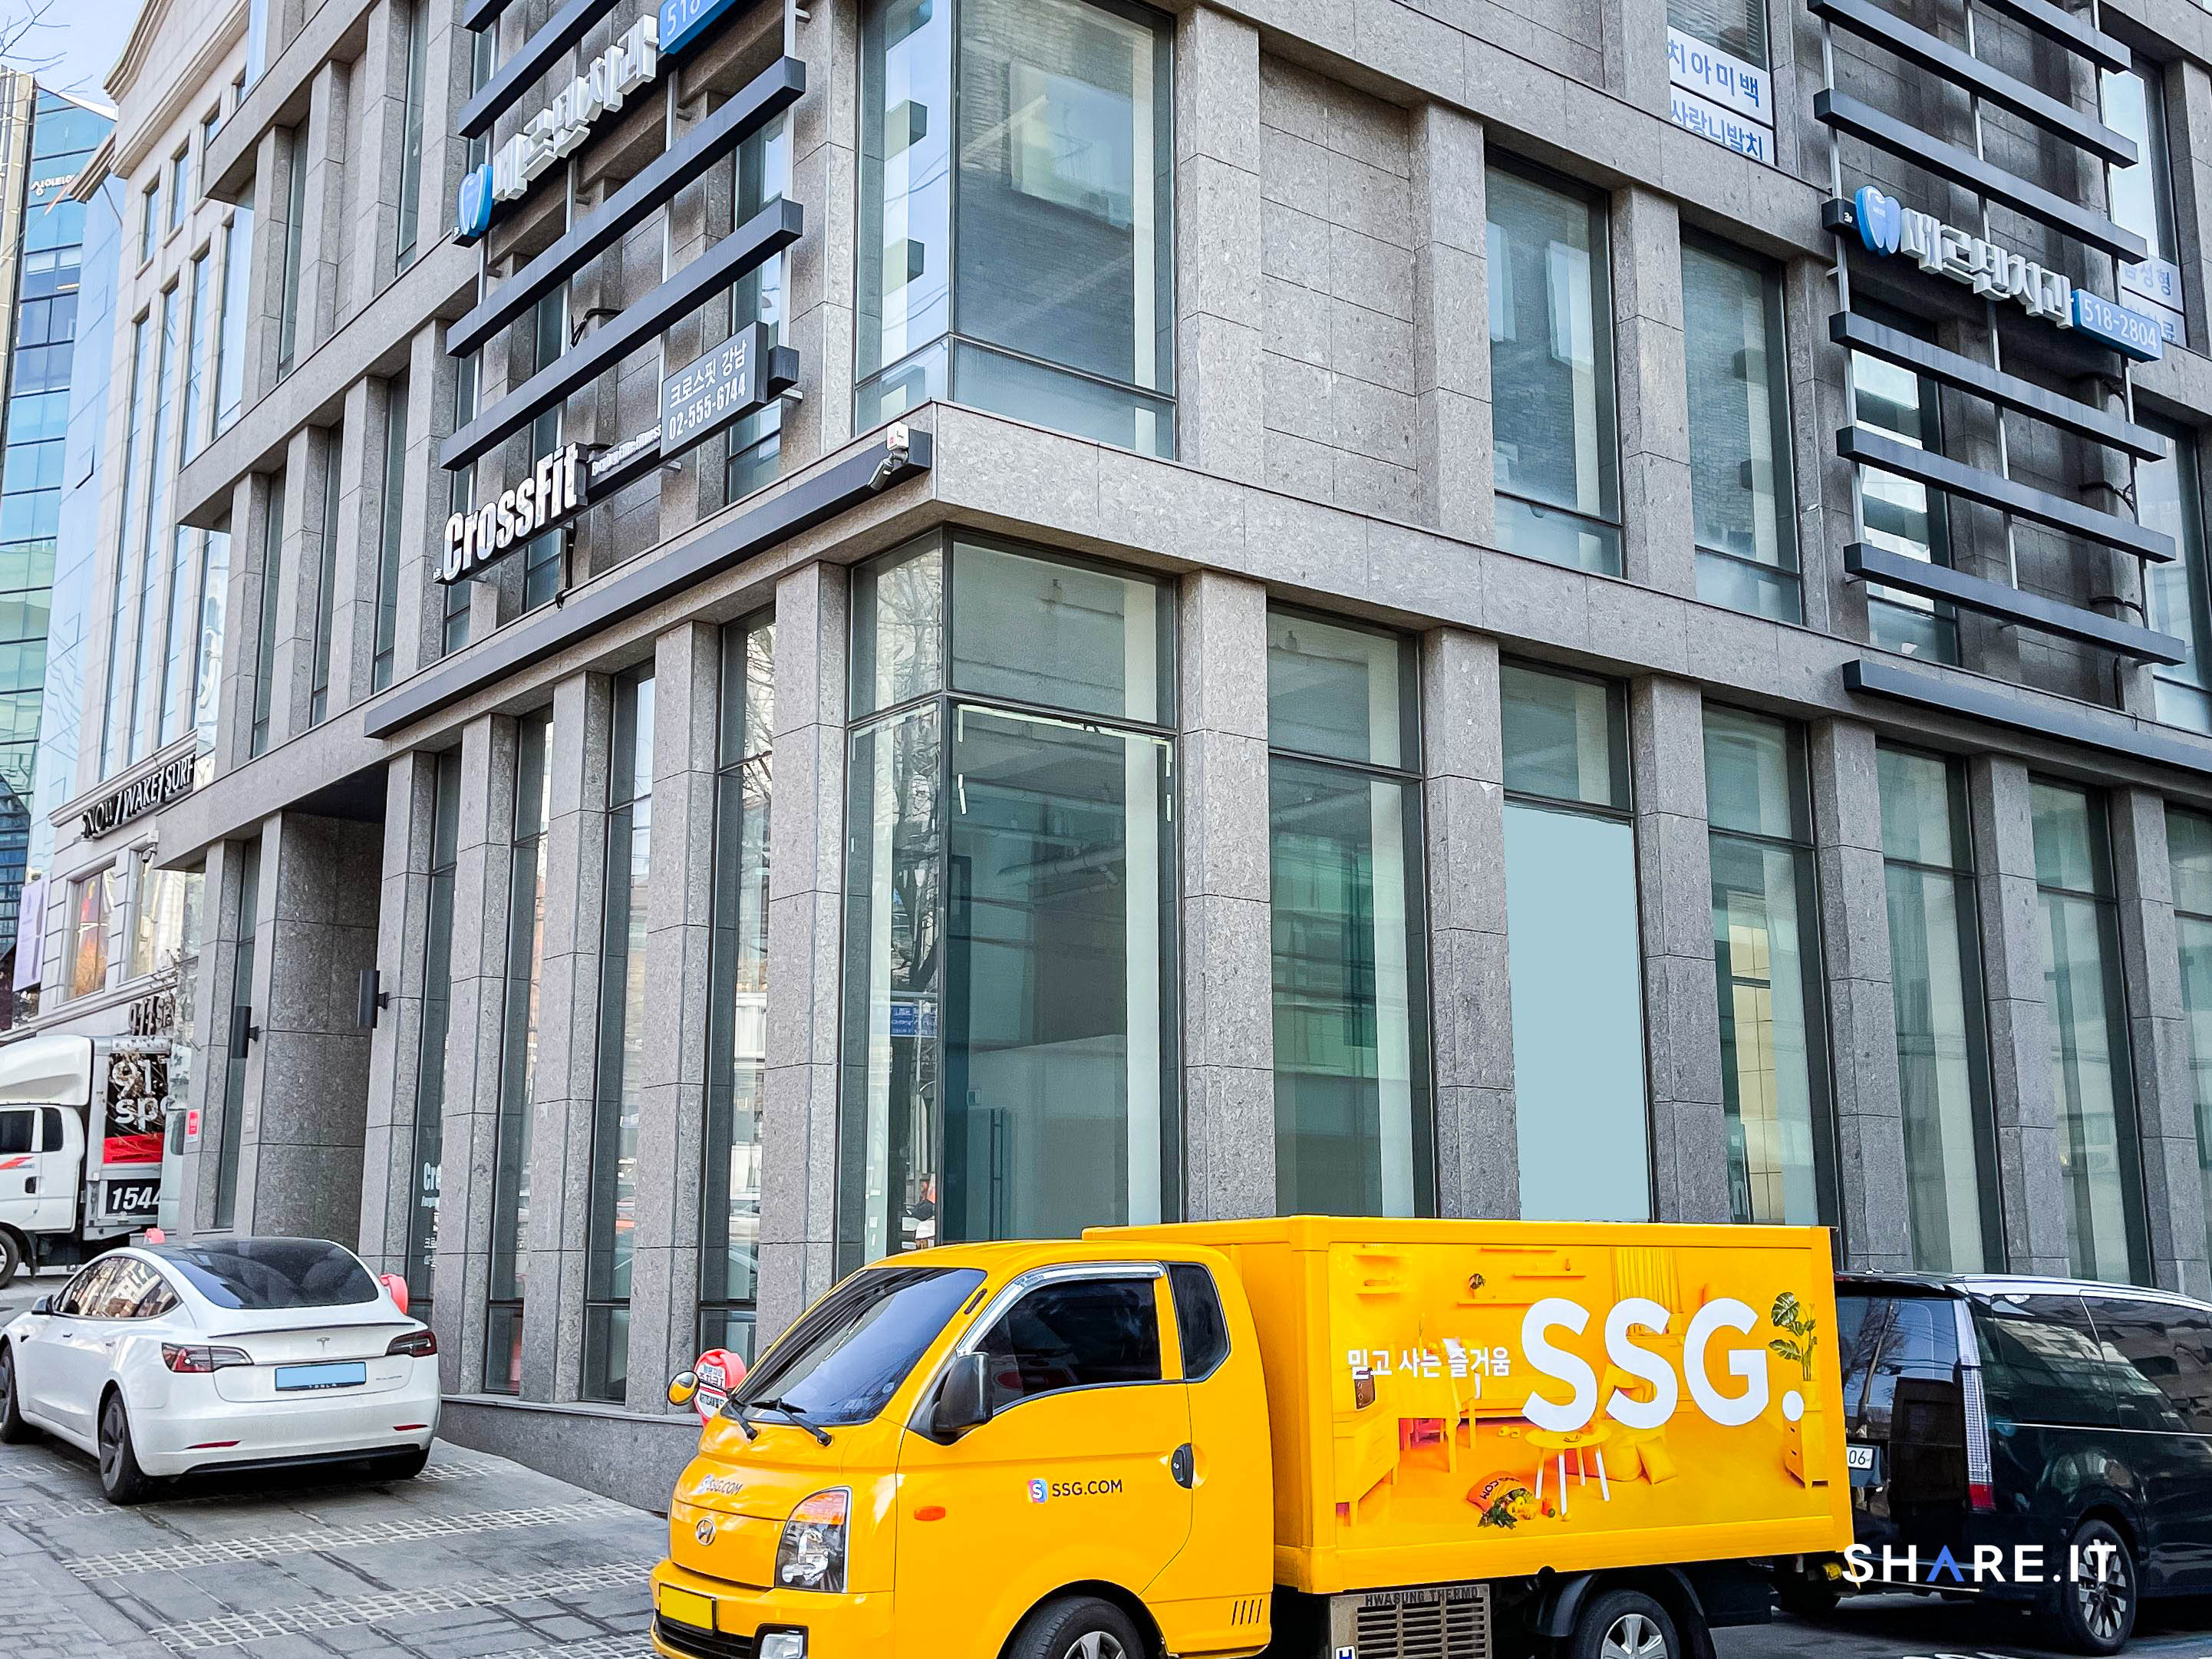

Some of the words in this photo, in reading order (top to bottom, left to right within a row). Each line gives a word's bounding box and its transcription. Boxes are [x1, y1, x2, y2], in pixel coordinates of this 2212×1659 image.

[1668, 39, 1759, 108] 치아미백
[1671, 100, 1762, 160] 사랑니발치
[2083, 298, 2158, 351] 518-2804
[668, 372, 747, 440] 02-555-6744
[669, 358, 716, 409] 크로스핏
[721, 339, 747, 377] 강남
[443, 443, 579, 581] CrossFit
[1347, 1348, 1393, 1380] 믿고
[1399, 1347, 1442, 1377] 사는
[1448, 1347, 1511, 1377] 즐거움
[1521, 1298, 1805, 1432] SSG.
[1051, 1479, 1123, 1497] SSG.COM
